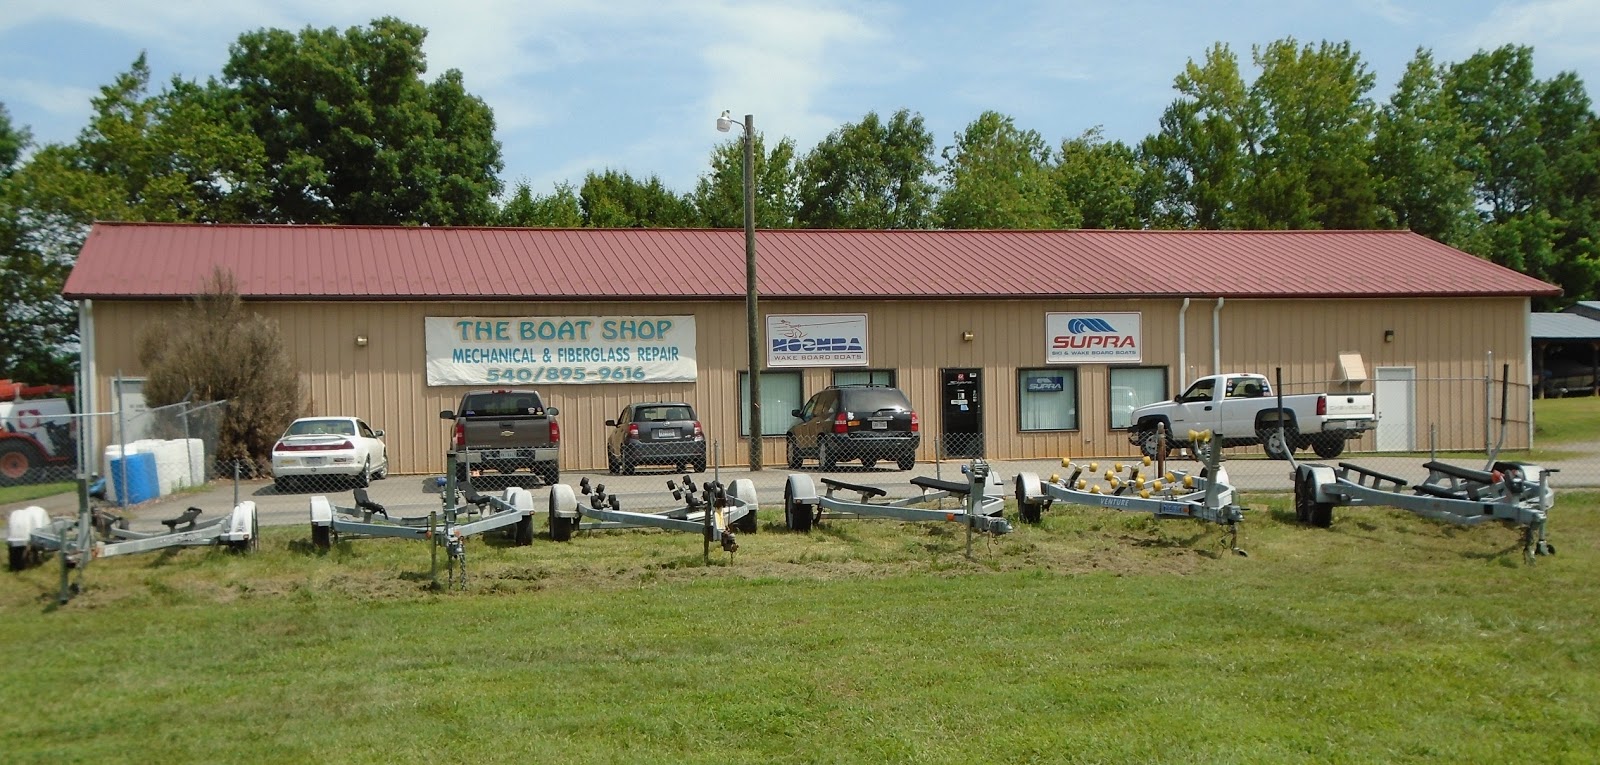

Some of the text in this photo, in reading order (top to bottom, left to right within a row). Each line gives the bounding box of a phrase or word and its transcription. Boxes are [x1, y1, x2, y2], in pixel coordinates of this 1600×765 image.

[456, 320, 672, 341] THE BOAT SHOP
[772, 337, 863, 352] MOOMBA
[1052, 335, 1136, 348] SUPRA
[452, 346, 679, 364] MECHANICAL & FIBERGLASS REPAIR
[486, 366, 646, 383] 540/895-9616
[1100, 498, 1130, 507] VENTURE
